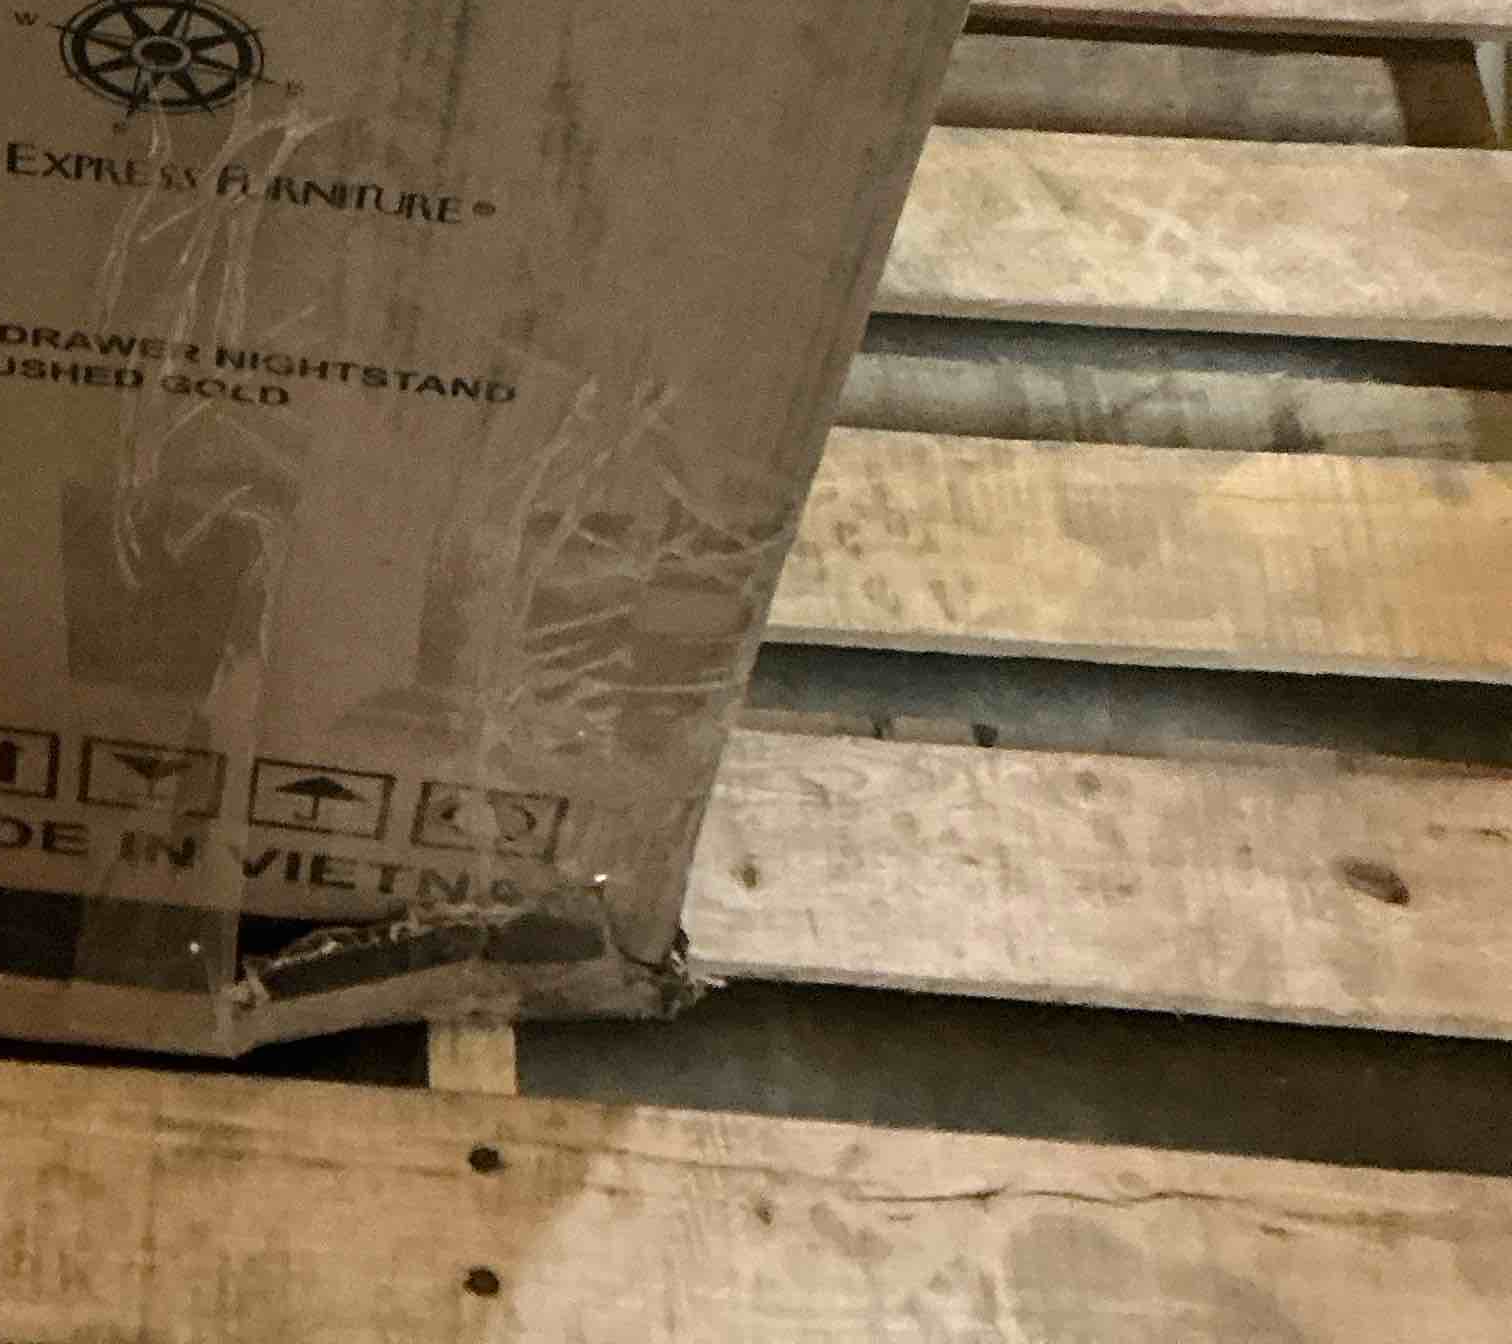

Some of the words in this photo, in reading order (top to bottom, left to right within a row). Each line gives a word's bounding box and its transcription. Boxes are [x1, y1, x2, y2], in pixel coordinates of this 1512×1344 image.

[160, 373, 289, 406] GOLD
[215, 344, 517, 404] NIGHTSTAND
[119, 829, 196, 868] IN
[226, 844, 524, 909] VIETN
